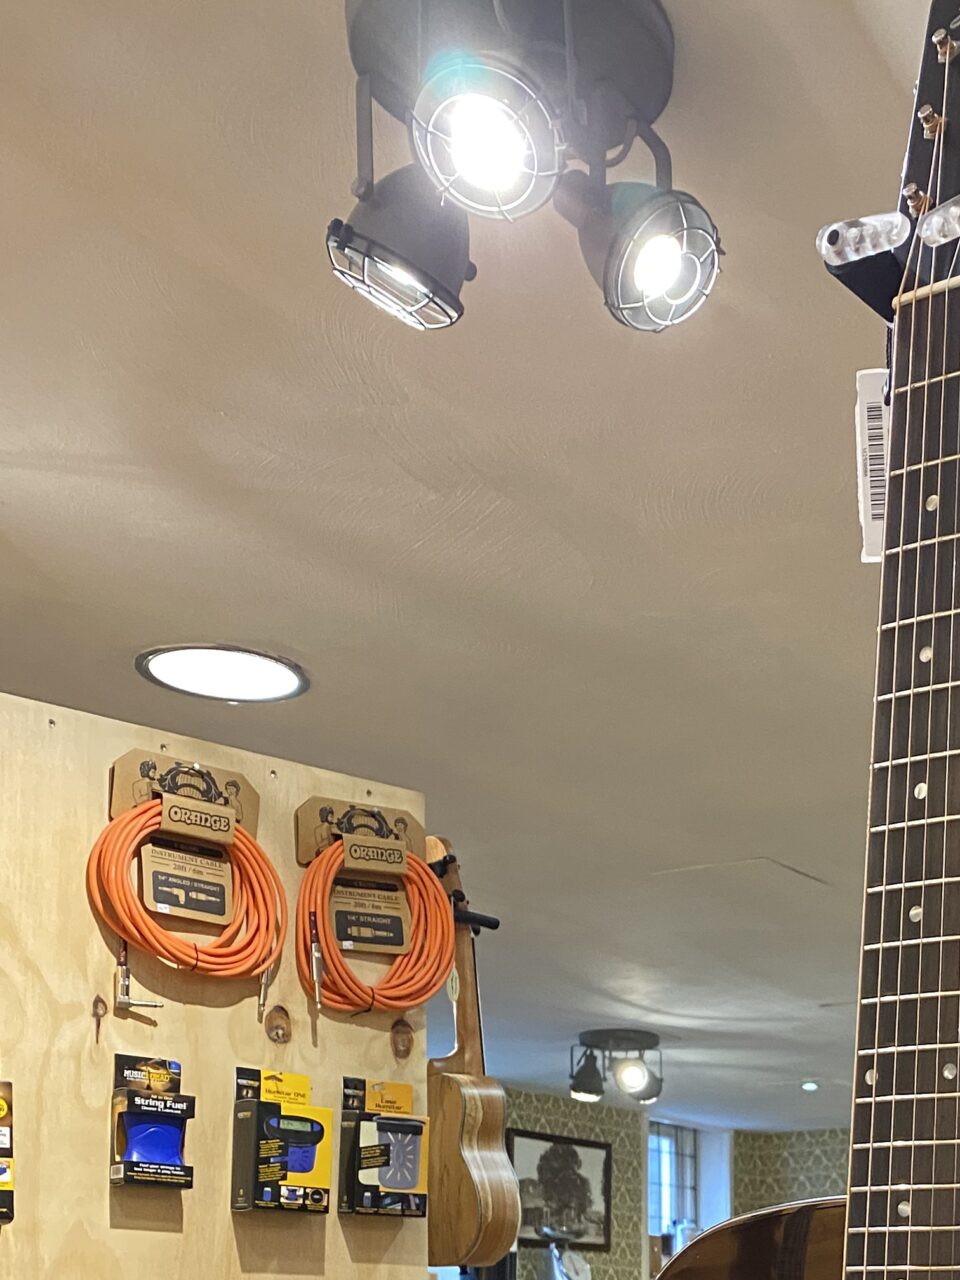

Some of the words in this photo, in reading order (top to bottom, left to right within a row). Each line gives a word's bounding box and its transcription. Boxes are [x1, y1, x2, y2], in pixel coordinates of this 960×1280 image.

[168, 804, 231, 832] ORANGE
[151, 849, 199, 864] INSTRUMENT
[200, 858, 223, 869] CABLE
[350, 844, 403, 863] ORANGE
[359, 915, 392, 924] STRAIGHT
[134, 1096, 164, 1109] String
[166, 1100, 187, 1110] Fuel
